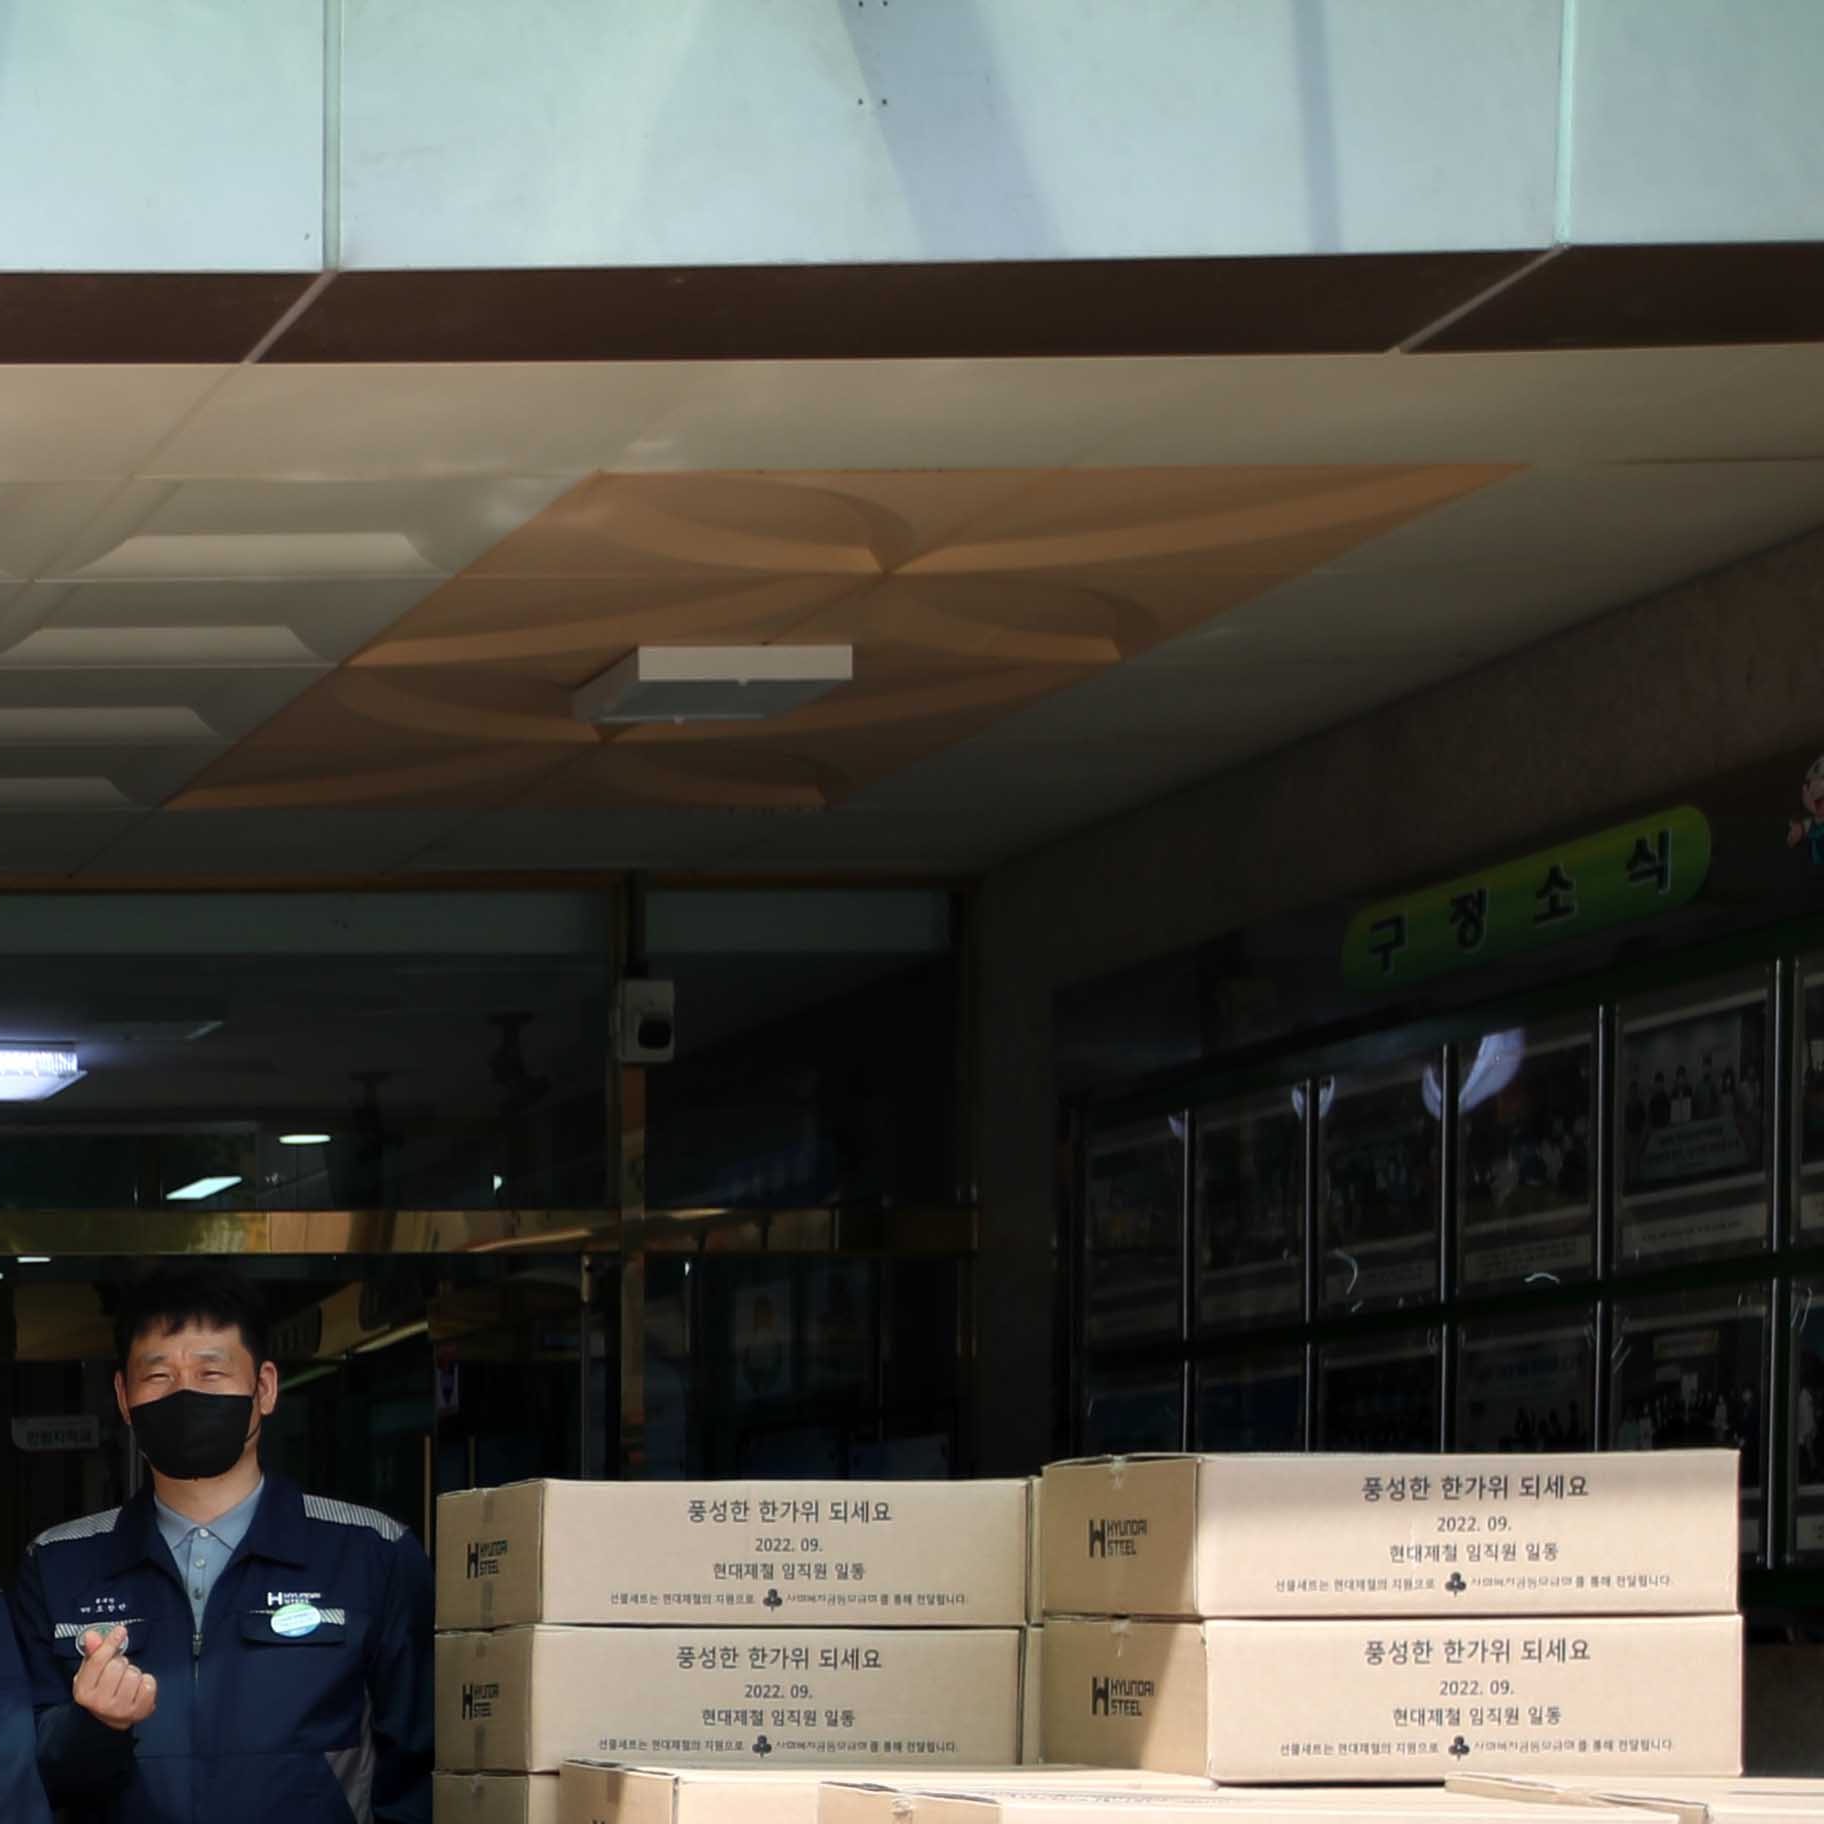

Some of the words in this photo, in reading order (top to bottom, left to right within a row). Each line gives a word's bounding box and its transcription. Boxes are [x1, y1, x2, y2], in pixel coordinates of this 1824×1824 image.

[1361, 1475, 1433, 1503] 풍성한
[1441, 1474, 1510, 1502] 한가위
[1519, 1474, 1590, 1501] 되세요
[687, 1499, 752, 1525] 풍성한
[758, 1499, 821, 1525] 한가위
[828, 1500, 893, 1525] 되세요
[1111, 1679, 1154, 1697] HYUNDAI
[1111, 1698, 1143, 1717] STEEL
